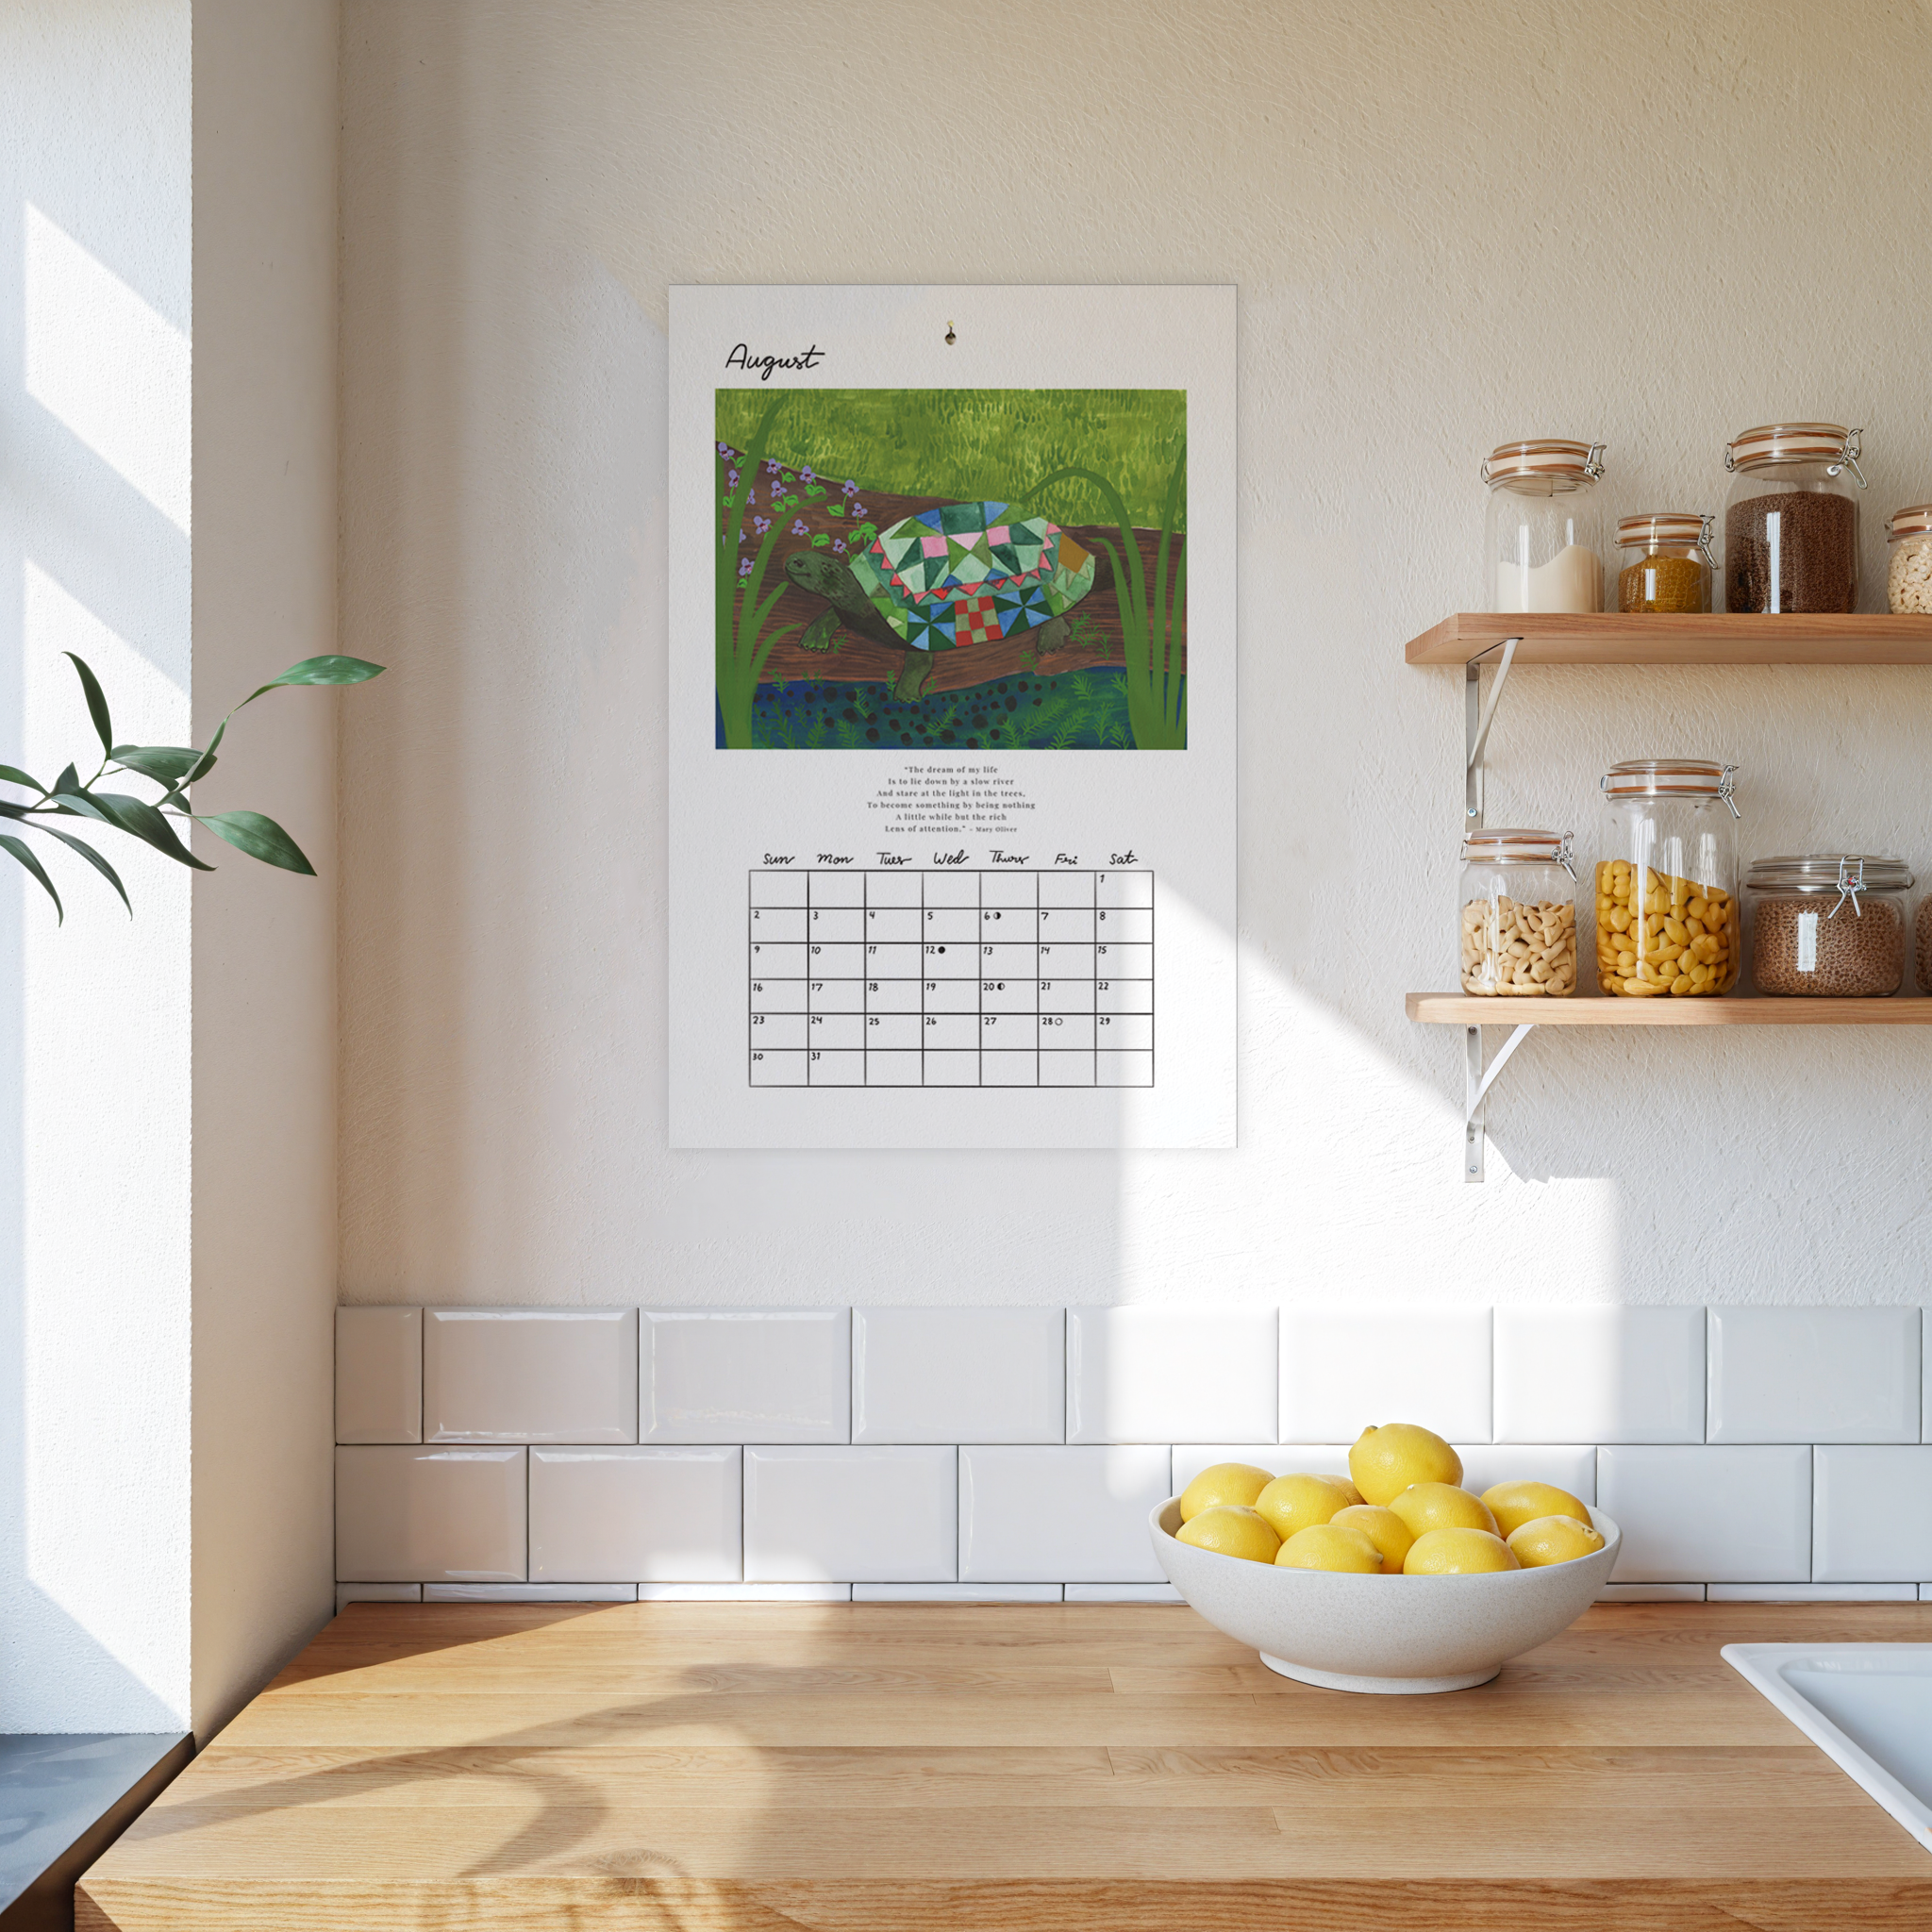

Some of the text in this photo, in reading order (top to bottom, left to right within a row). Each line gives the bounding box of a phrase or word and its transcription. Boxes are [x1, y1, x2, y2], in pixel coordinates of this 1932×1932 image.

[724, 342, 826, 381] August
[926, 765, 954, 774] dream
[956, 765, 966, 774] of
[982, 765, 999, 774] life
[888, 777, 897, 786] Is
[898, 777, 908, 786] to
[909, 777, 923, 786] lie
[924, 777, 948, 786] down
[949, 777, 960, 787] by
[970, 777, 991, 786] slow
[992, 777, 1015, 786] river
[875, 789, 893, 797] And
[895, 790, 919, 798] stare
[932, 789, 947, 798] the
[948, 789, 970, 798] light
[983, 789, 998, 798] the
[866, 801, 1036, 810] To become something by being nothing
[904, 812, 926, 822] little
[928, 812, 953, 822] while
[954, 812, 970, 821] but
[972, 812, 987, 822] the
[989, 812, 1008, 822] rich
[884, 824, 906, 833] Lens
[907, 824, 918, 833] of
[974, 825, 993, 834] Mary
[762, 848, 1139, 866] Sun Mon Tues Wed Thurs Fri Sat
[1099, 874, 1106, 884] 1
[754, 910, 1107, 922] 2 3 4 5 6 7 8
[754, 945, 1108, 956] 9 10 11 12 13 14 15
[752, 981, 1109, 992] 16 17 18 19 20 21 22
[752, 1016, 1111, 1026] 23 24 25 26 27 28 29
[752, 1052, 821, 1061] 30 31
